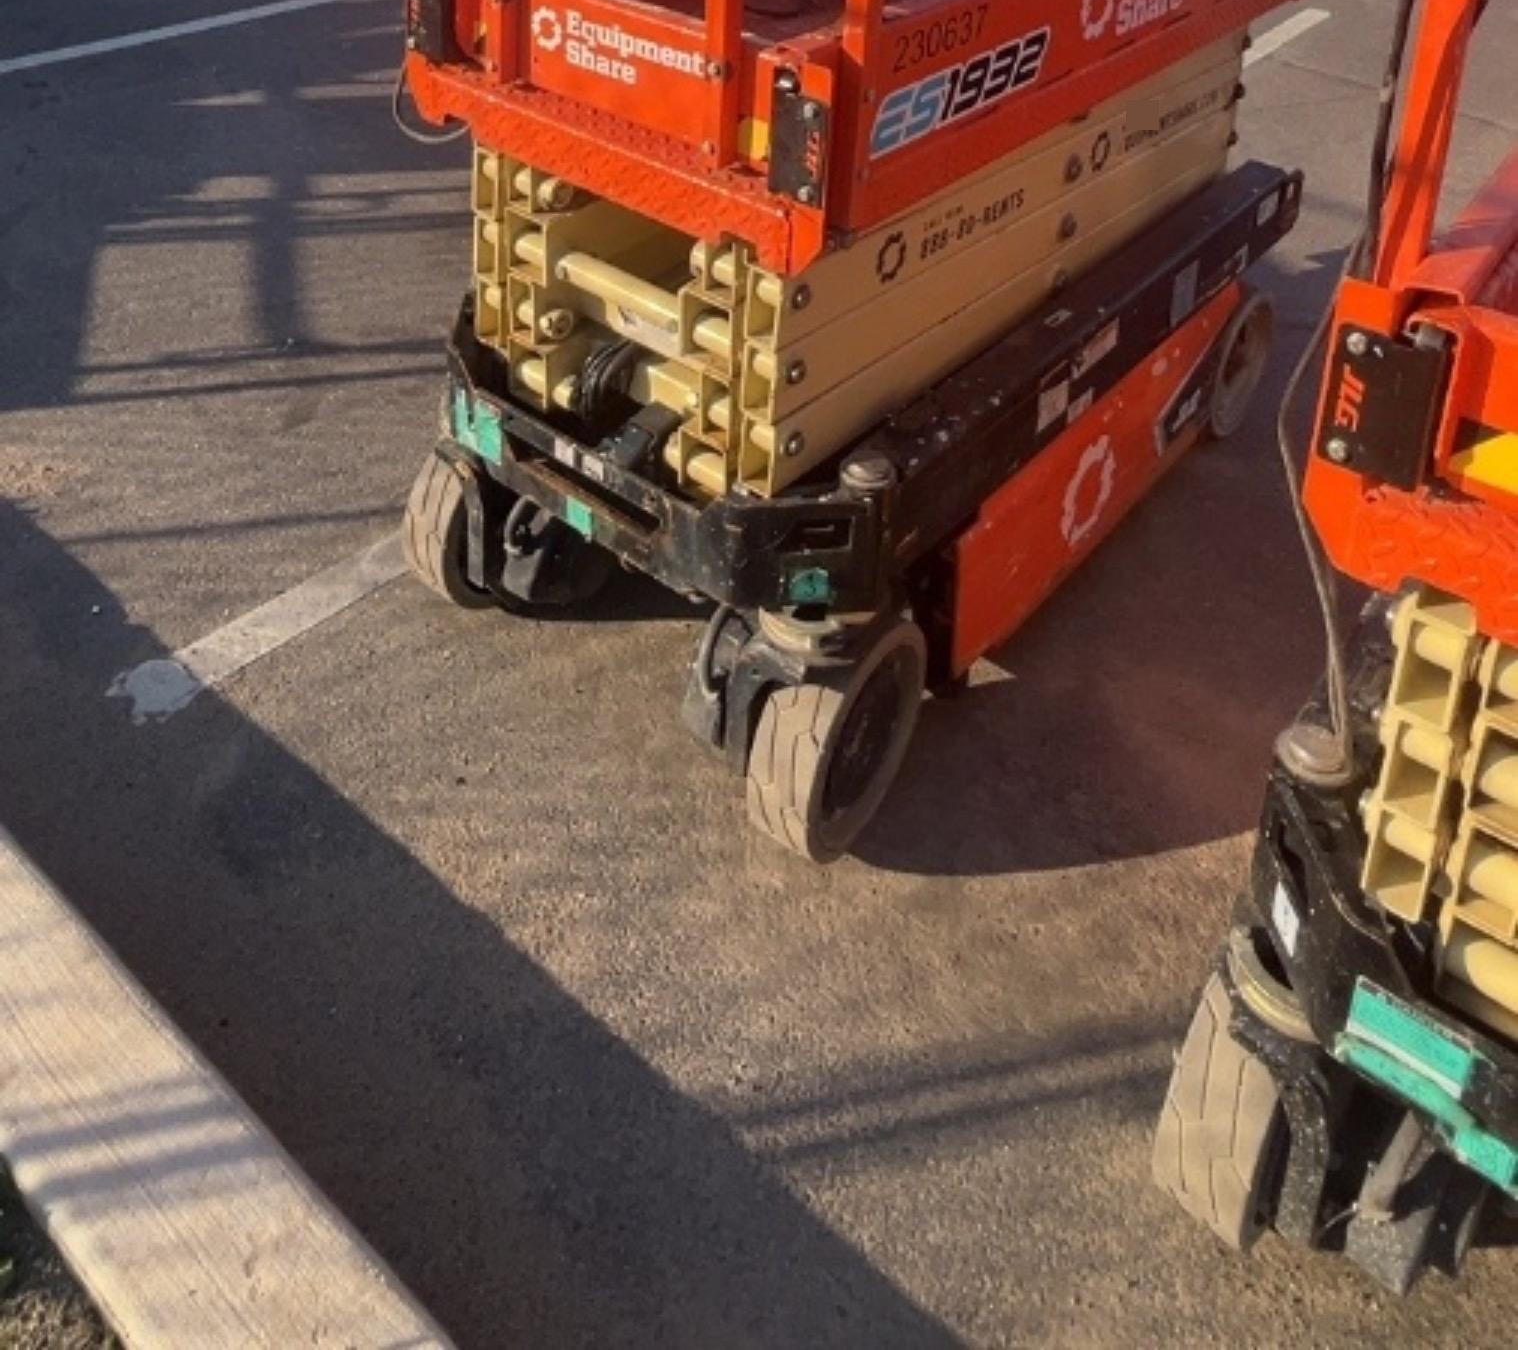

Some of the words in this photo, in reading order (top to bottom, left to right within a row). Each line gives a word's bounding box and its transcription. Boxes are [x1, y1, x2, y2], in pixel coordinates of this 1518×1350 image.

[565, 10, 706, 79] Equipment
[565, 38, 638, 85] Share
[893, 2, 990, 73] 230637
[868, 25, 1051, 160] ES1932
[1333, 361, 1367, 433] JLG
